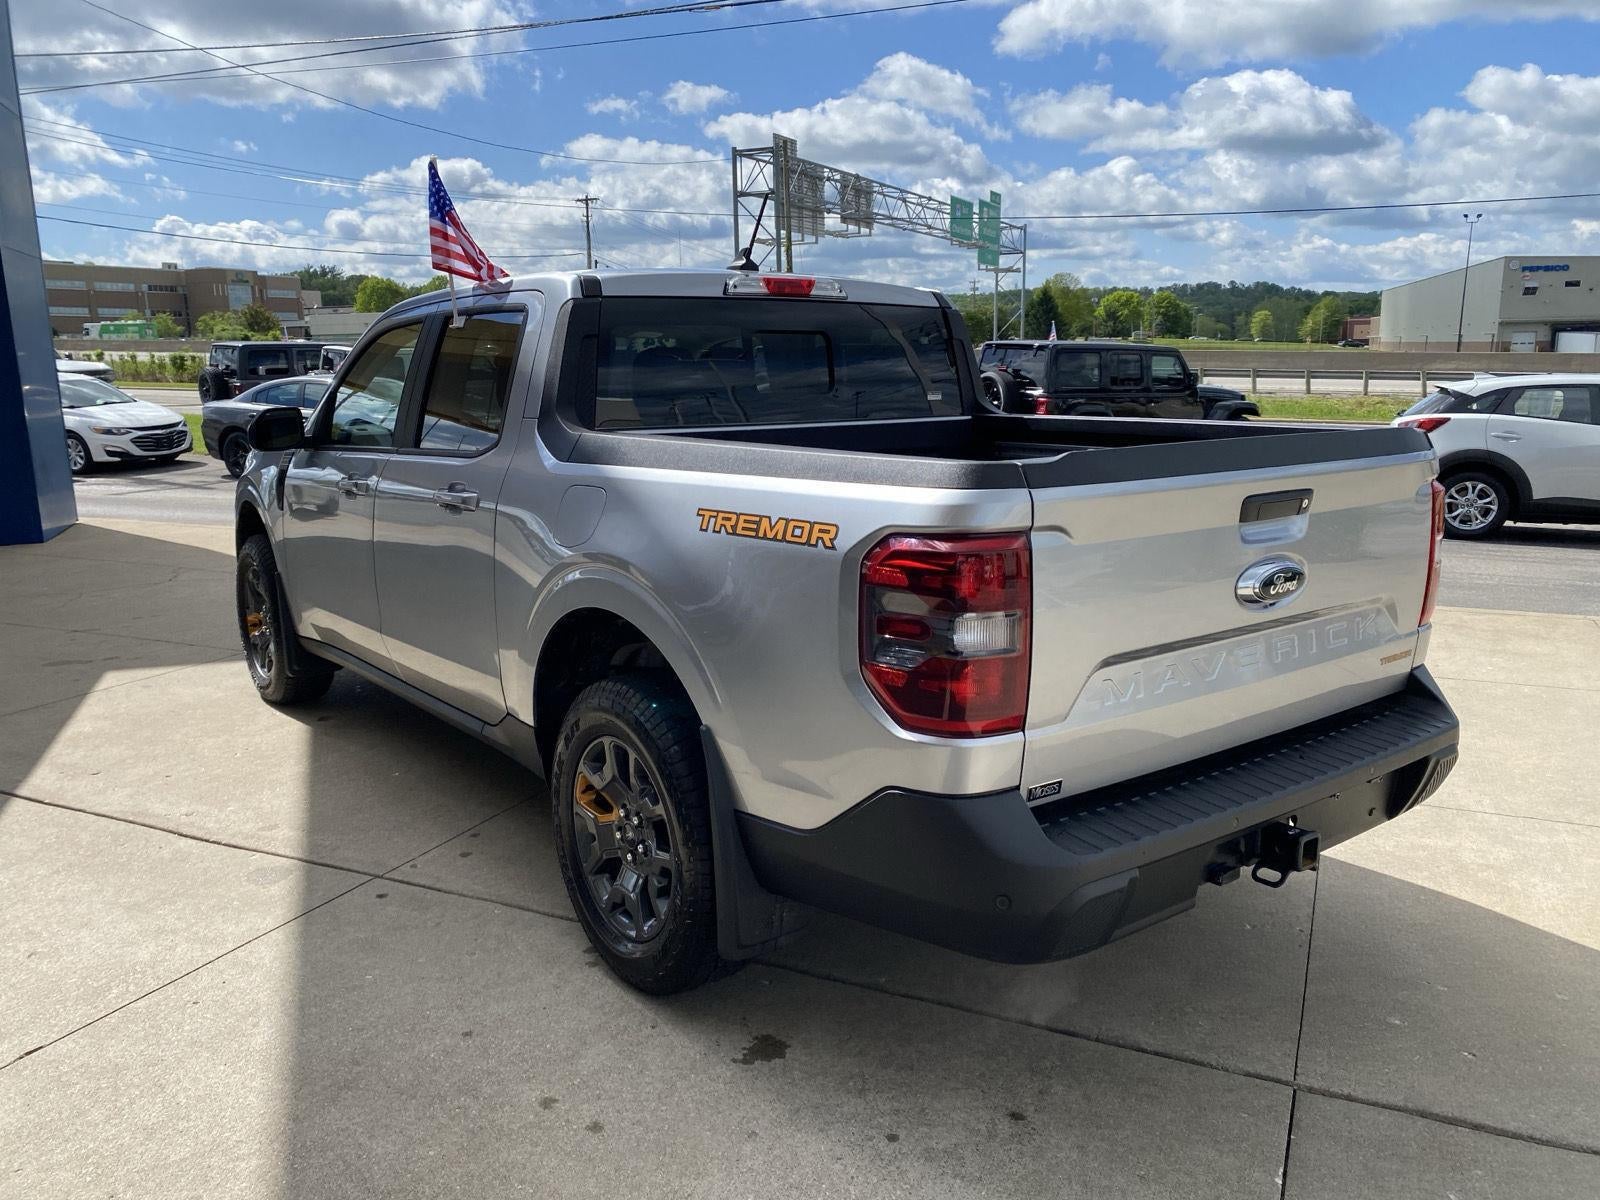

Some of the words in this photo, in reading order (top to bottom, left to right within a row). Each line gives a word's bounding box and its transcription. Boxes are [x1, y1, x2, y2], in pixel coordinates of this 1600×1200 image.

[697, 508, 839, 550] TREMOR
[1270, 572, 1299, 595] Ford
[1101, 613, 1379, 706] MAVERICK
